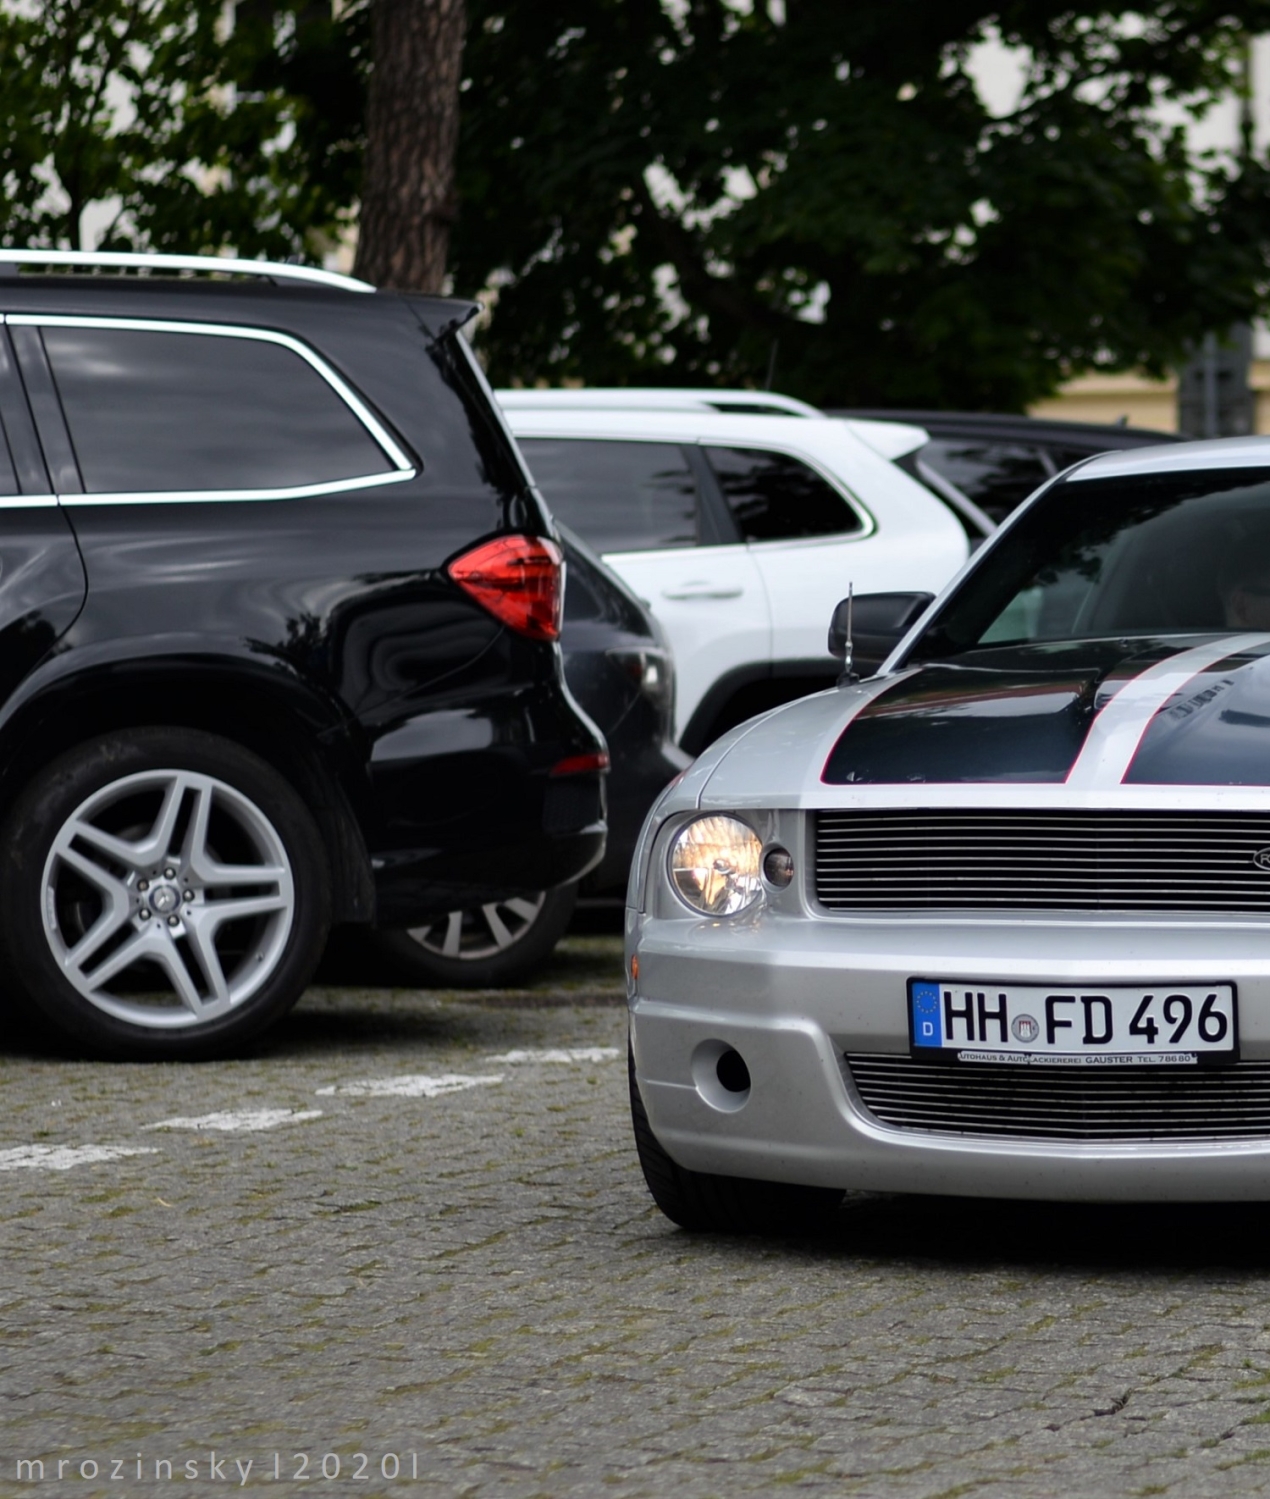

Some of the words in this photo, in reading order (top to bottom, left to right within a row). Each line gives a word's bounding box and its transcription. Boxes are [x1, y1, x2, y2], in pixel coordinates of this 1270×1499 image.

[943, 991, 1009, 1042] HH
[1045, 994, 1114, 1045] FD
[1128, 993, 1228, 1044] 496
[922, 1022, 934, 1036] D
[999, 1054, 1006, 1062] &
[1085, 1056, 1133, 1064] GAUSTER
